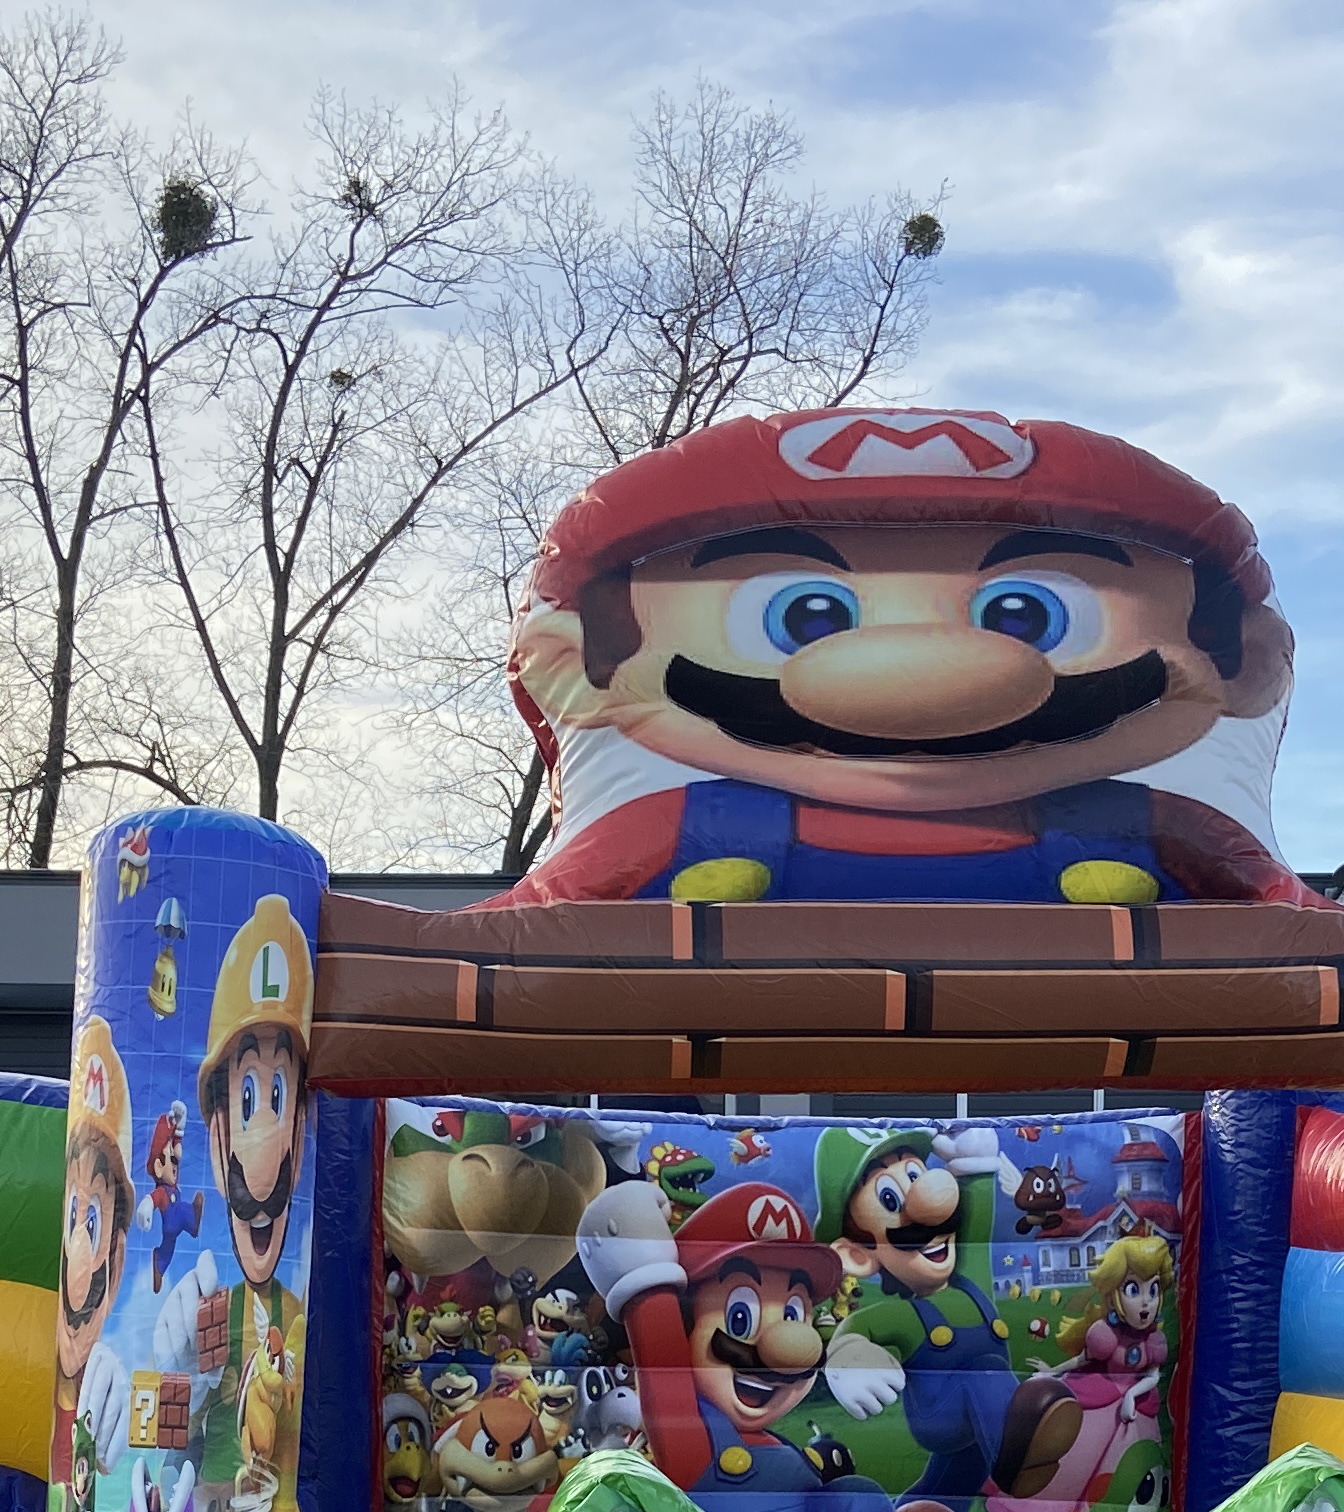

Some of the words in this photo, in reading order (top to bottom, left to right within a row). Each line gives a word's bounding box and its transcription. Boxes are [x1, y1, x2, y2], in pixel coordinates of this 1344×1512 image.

[806, 418, 1014, 473] M
[261, 945, 281, 999] L
[83, 1059, 106, 1112] M
[752, 1197, 798, 1240] M
